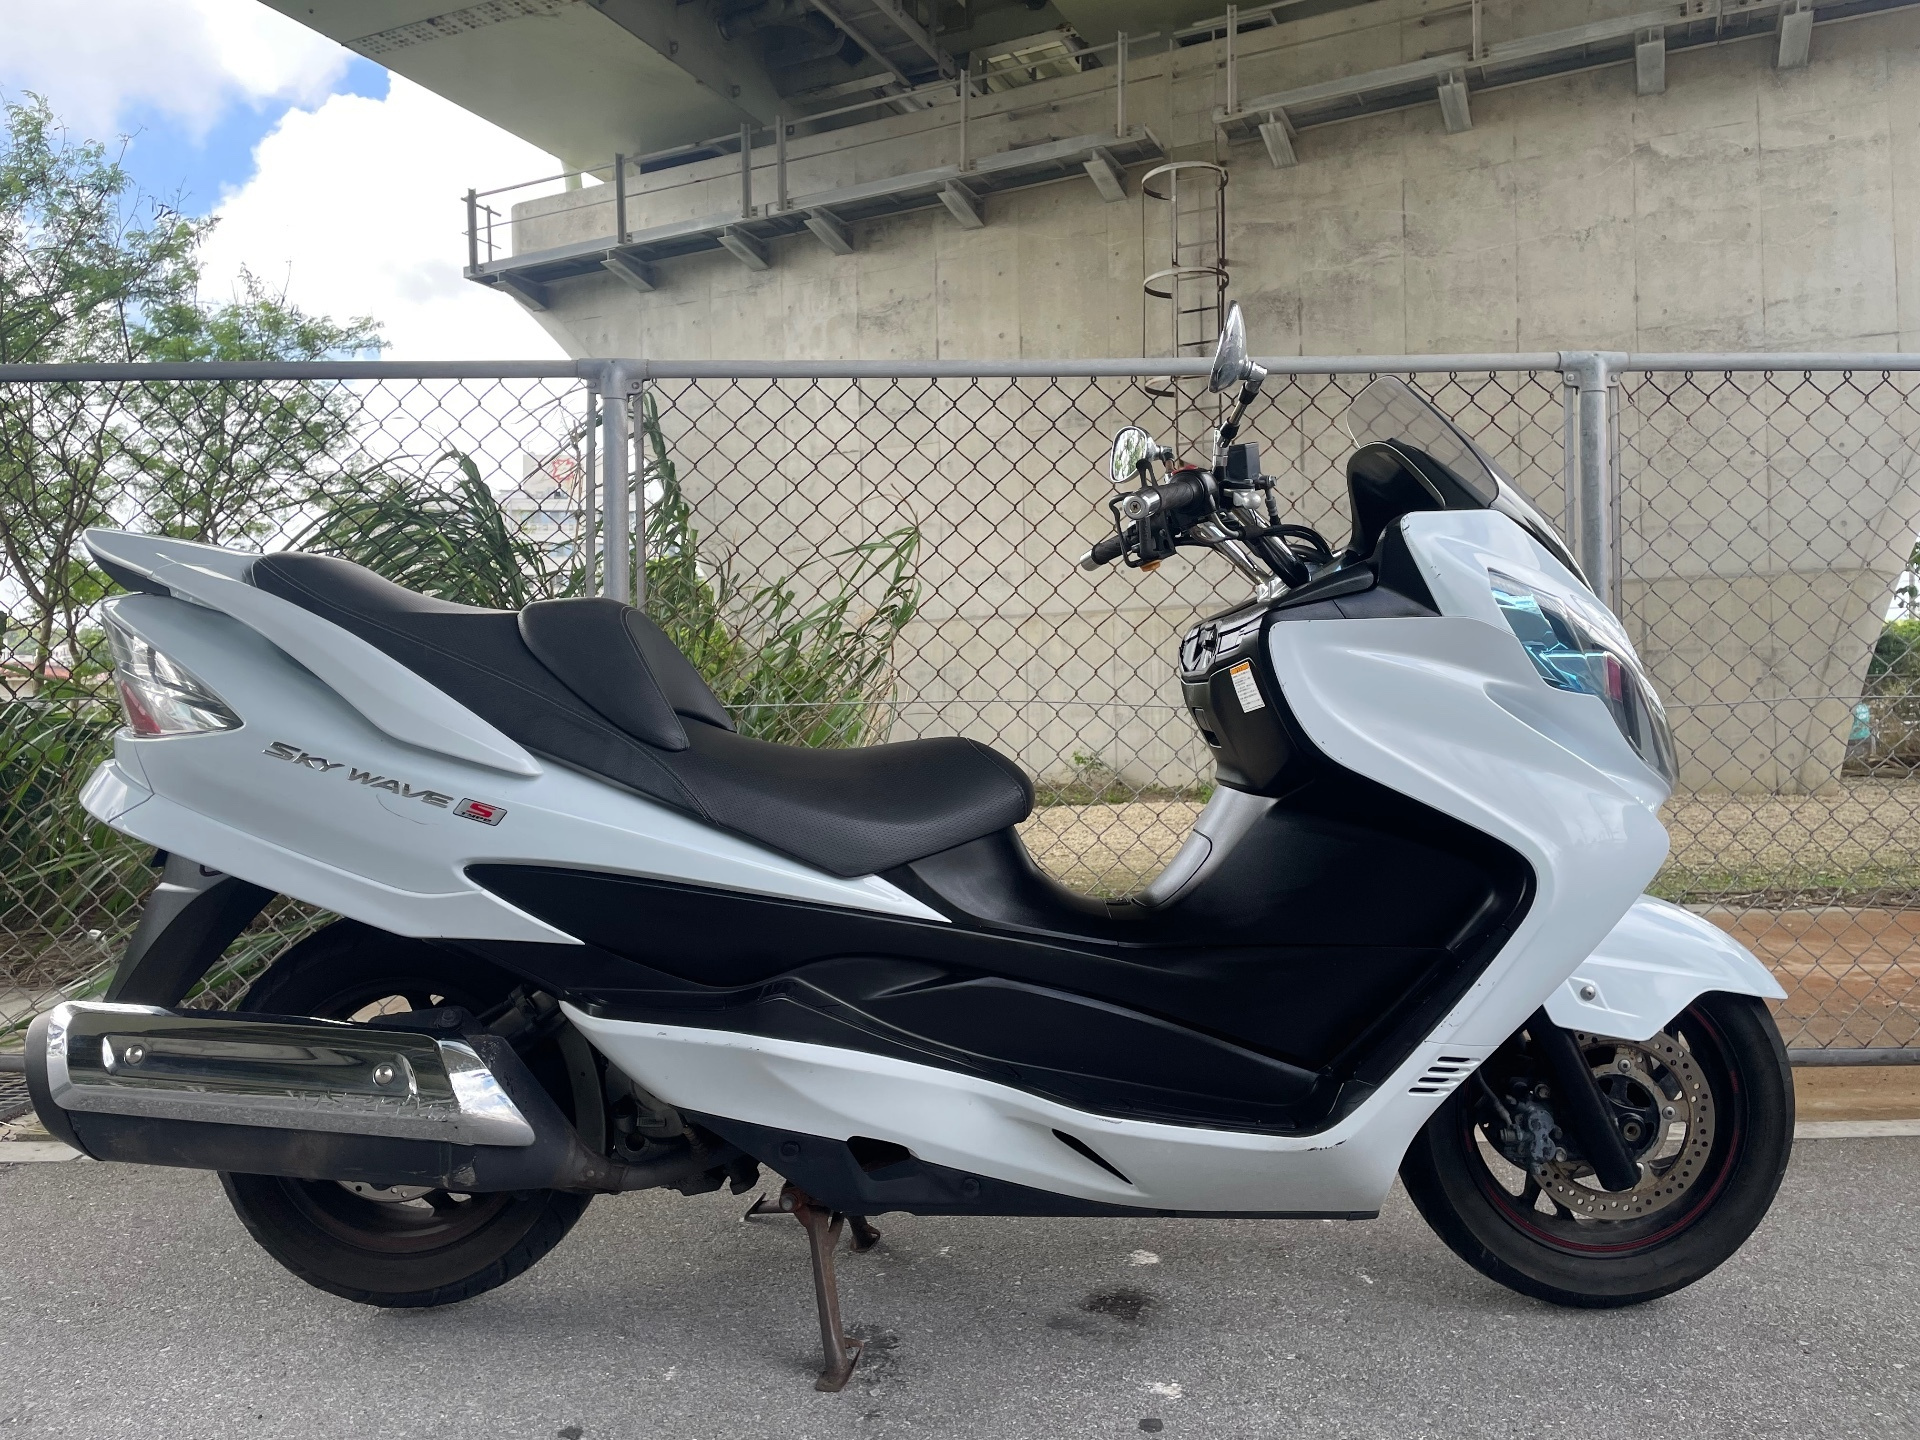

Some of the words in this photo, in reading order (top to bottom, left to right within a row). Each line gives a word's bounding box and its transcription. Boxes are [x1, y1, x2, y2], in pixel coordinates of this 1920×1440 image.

[261, 741, 345, 772] SKY
[347, 767, 454, 808] WAVE
[466, 802, 496, 818] S
